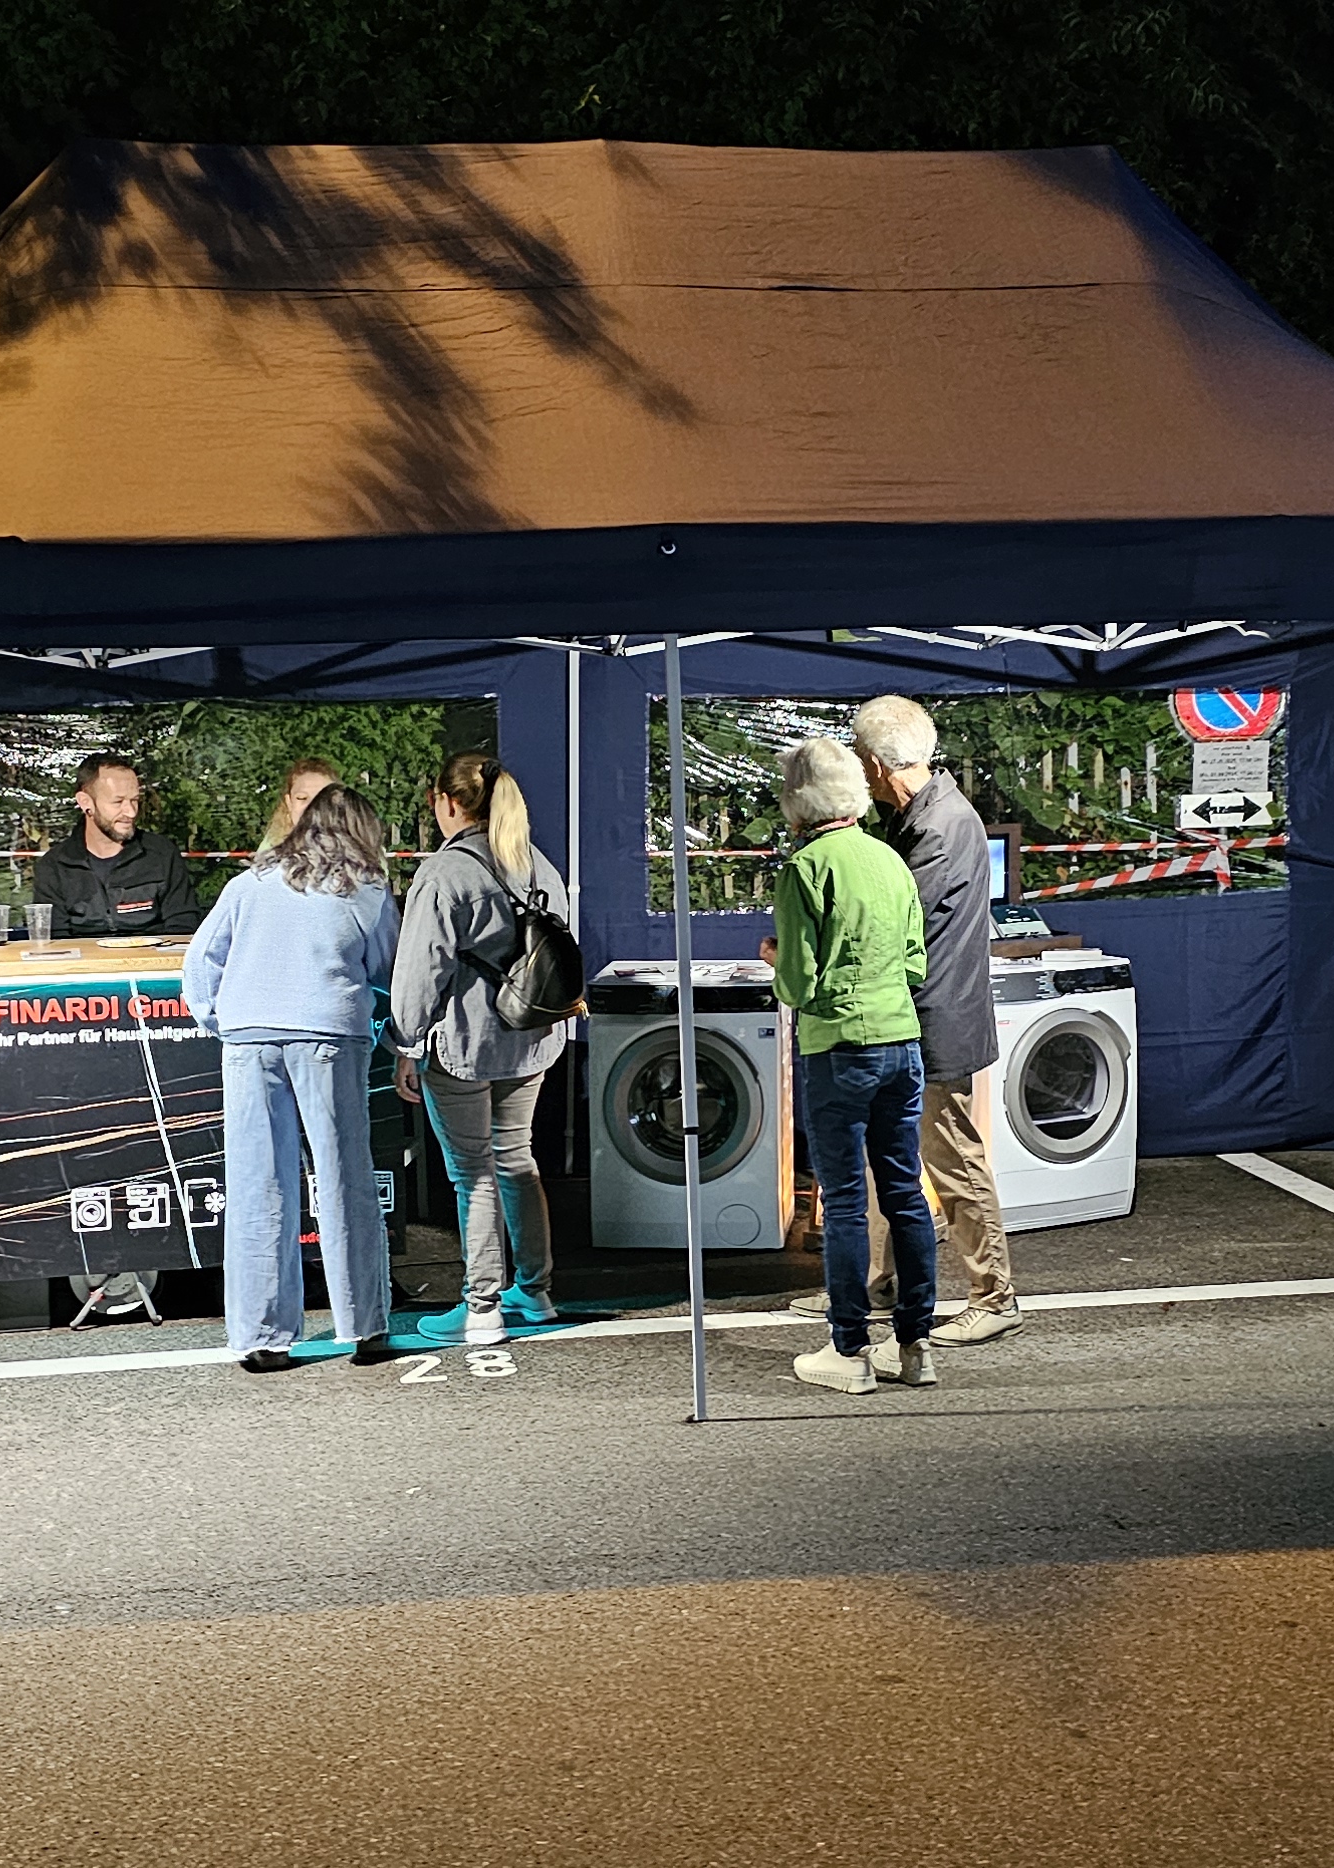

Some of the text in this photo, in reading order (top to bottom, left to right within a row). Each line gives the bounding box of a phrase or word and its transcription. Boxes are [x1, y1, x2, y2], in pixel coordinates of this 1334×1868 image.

[127, 993, 195, 1018] Gmb
[17, 1031, 78, 1046] Partner
[79, 1028, 101, 1044] für
[394, 1348, 519, 1385] 28
